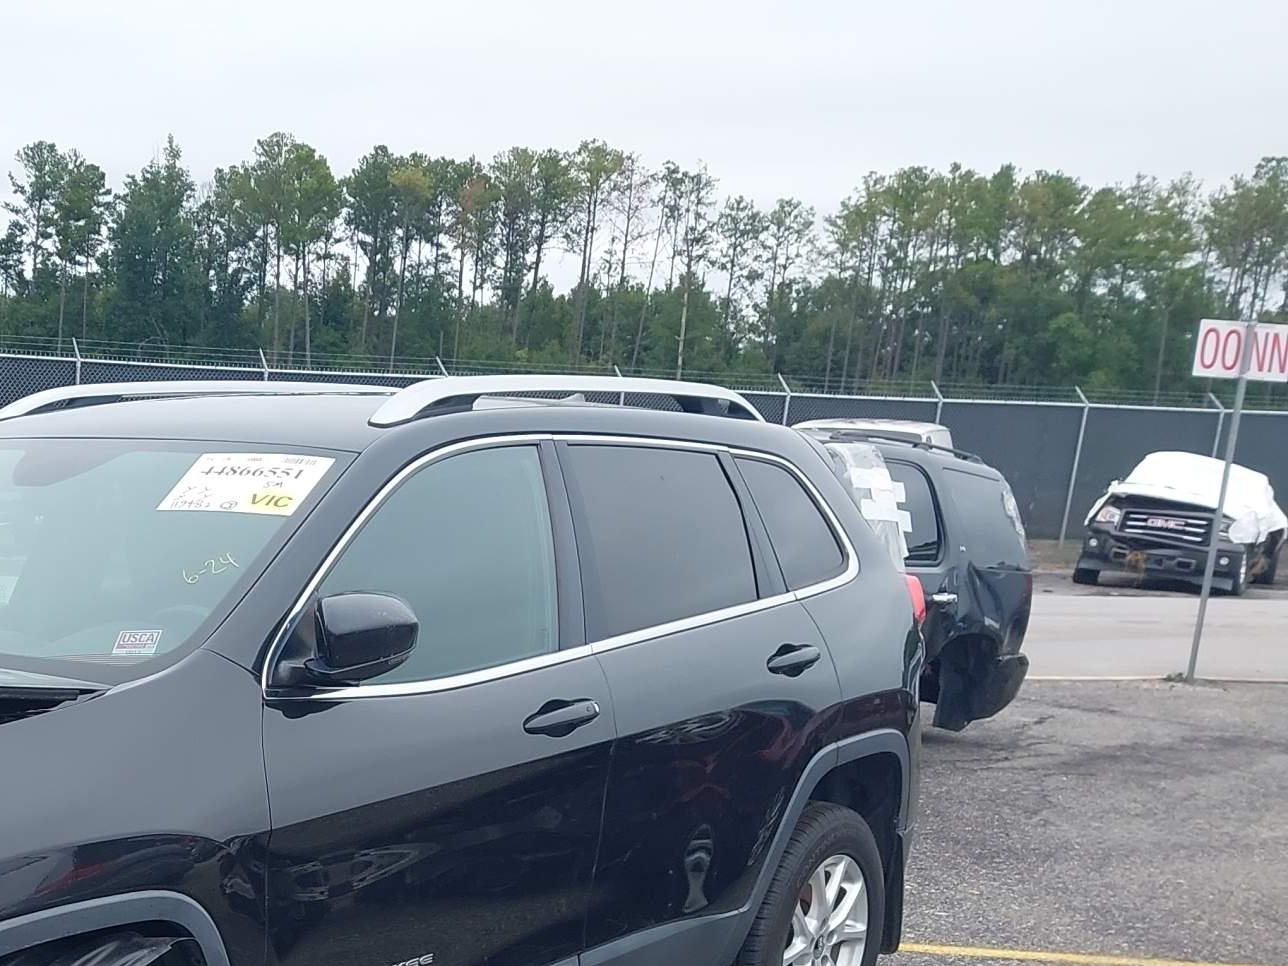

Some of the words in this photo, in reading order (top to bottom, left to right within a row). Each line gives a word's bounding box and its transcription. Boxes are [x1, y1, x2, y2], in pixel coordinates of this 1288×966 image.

[200, 464, 305, 481] 44866551
[250, 493, 293, 508] VIC
[1146, 518, 1186, 531] GMC
[183, 552, 240, 584] 6-24
[121, 633, 155, 643] USCA
